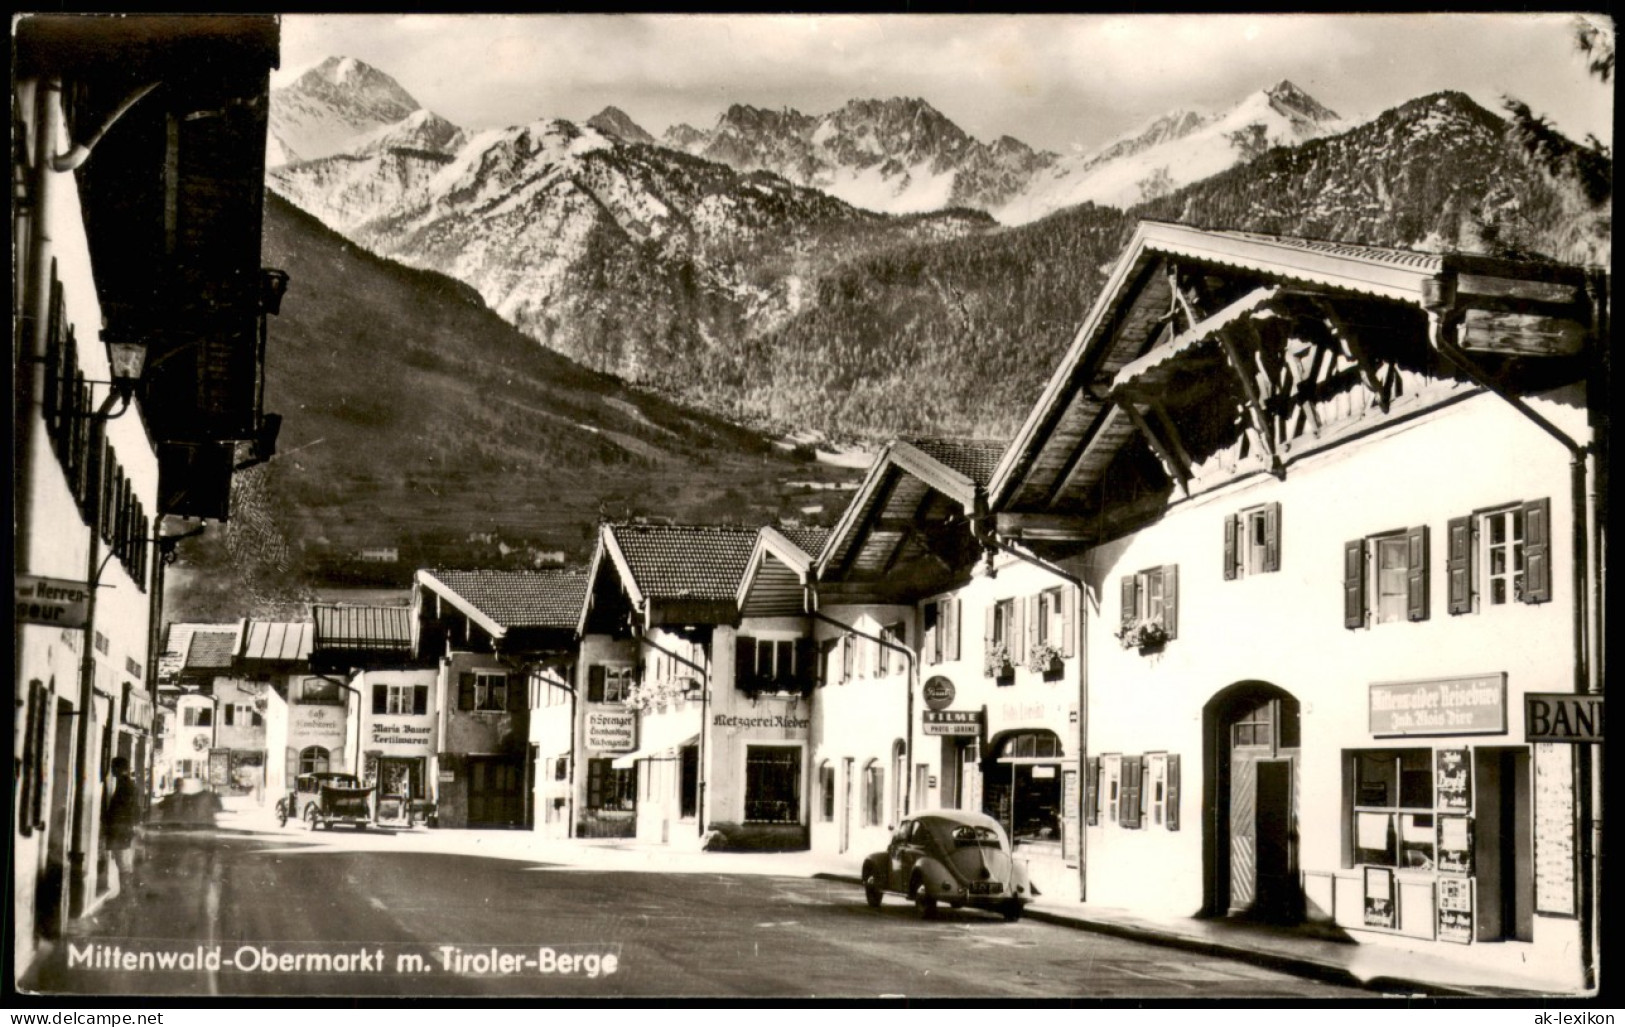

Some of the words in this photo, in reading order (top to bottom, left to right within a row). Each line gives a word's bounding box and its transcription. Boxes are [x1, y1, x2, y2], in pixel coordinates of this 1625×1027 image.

[37, 582, 88, 602] Herren-
[1440, 681, 1500, 707] Reisebüro
[712, 713, 773, 729] Metzgerei
[774, 714, 811, 729] Rieder
[929, 712, 976, 721] FILME
[372, 723, 401, 734] Maria
[403, 723, 432, 734] Bauer
[372, 734, 429, 745] Textilwaren
